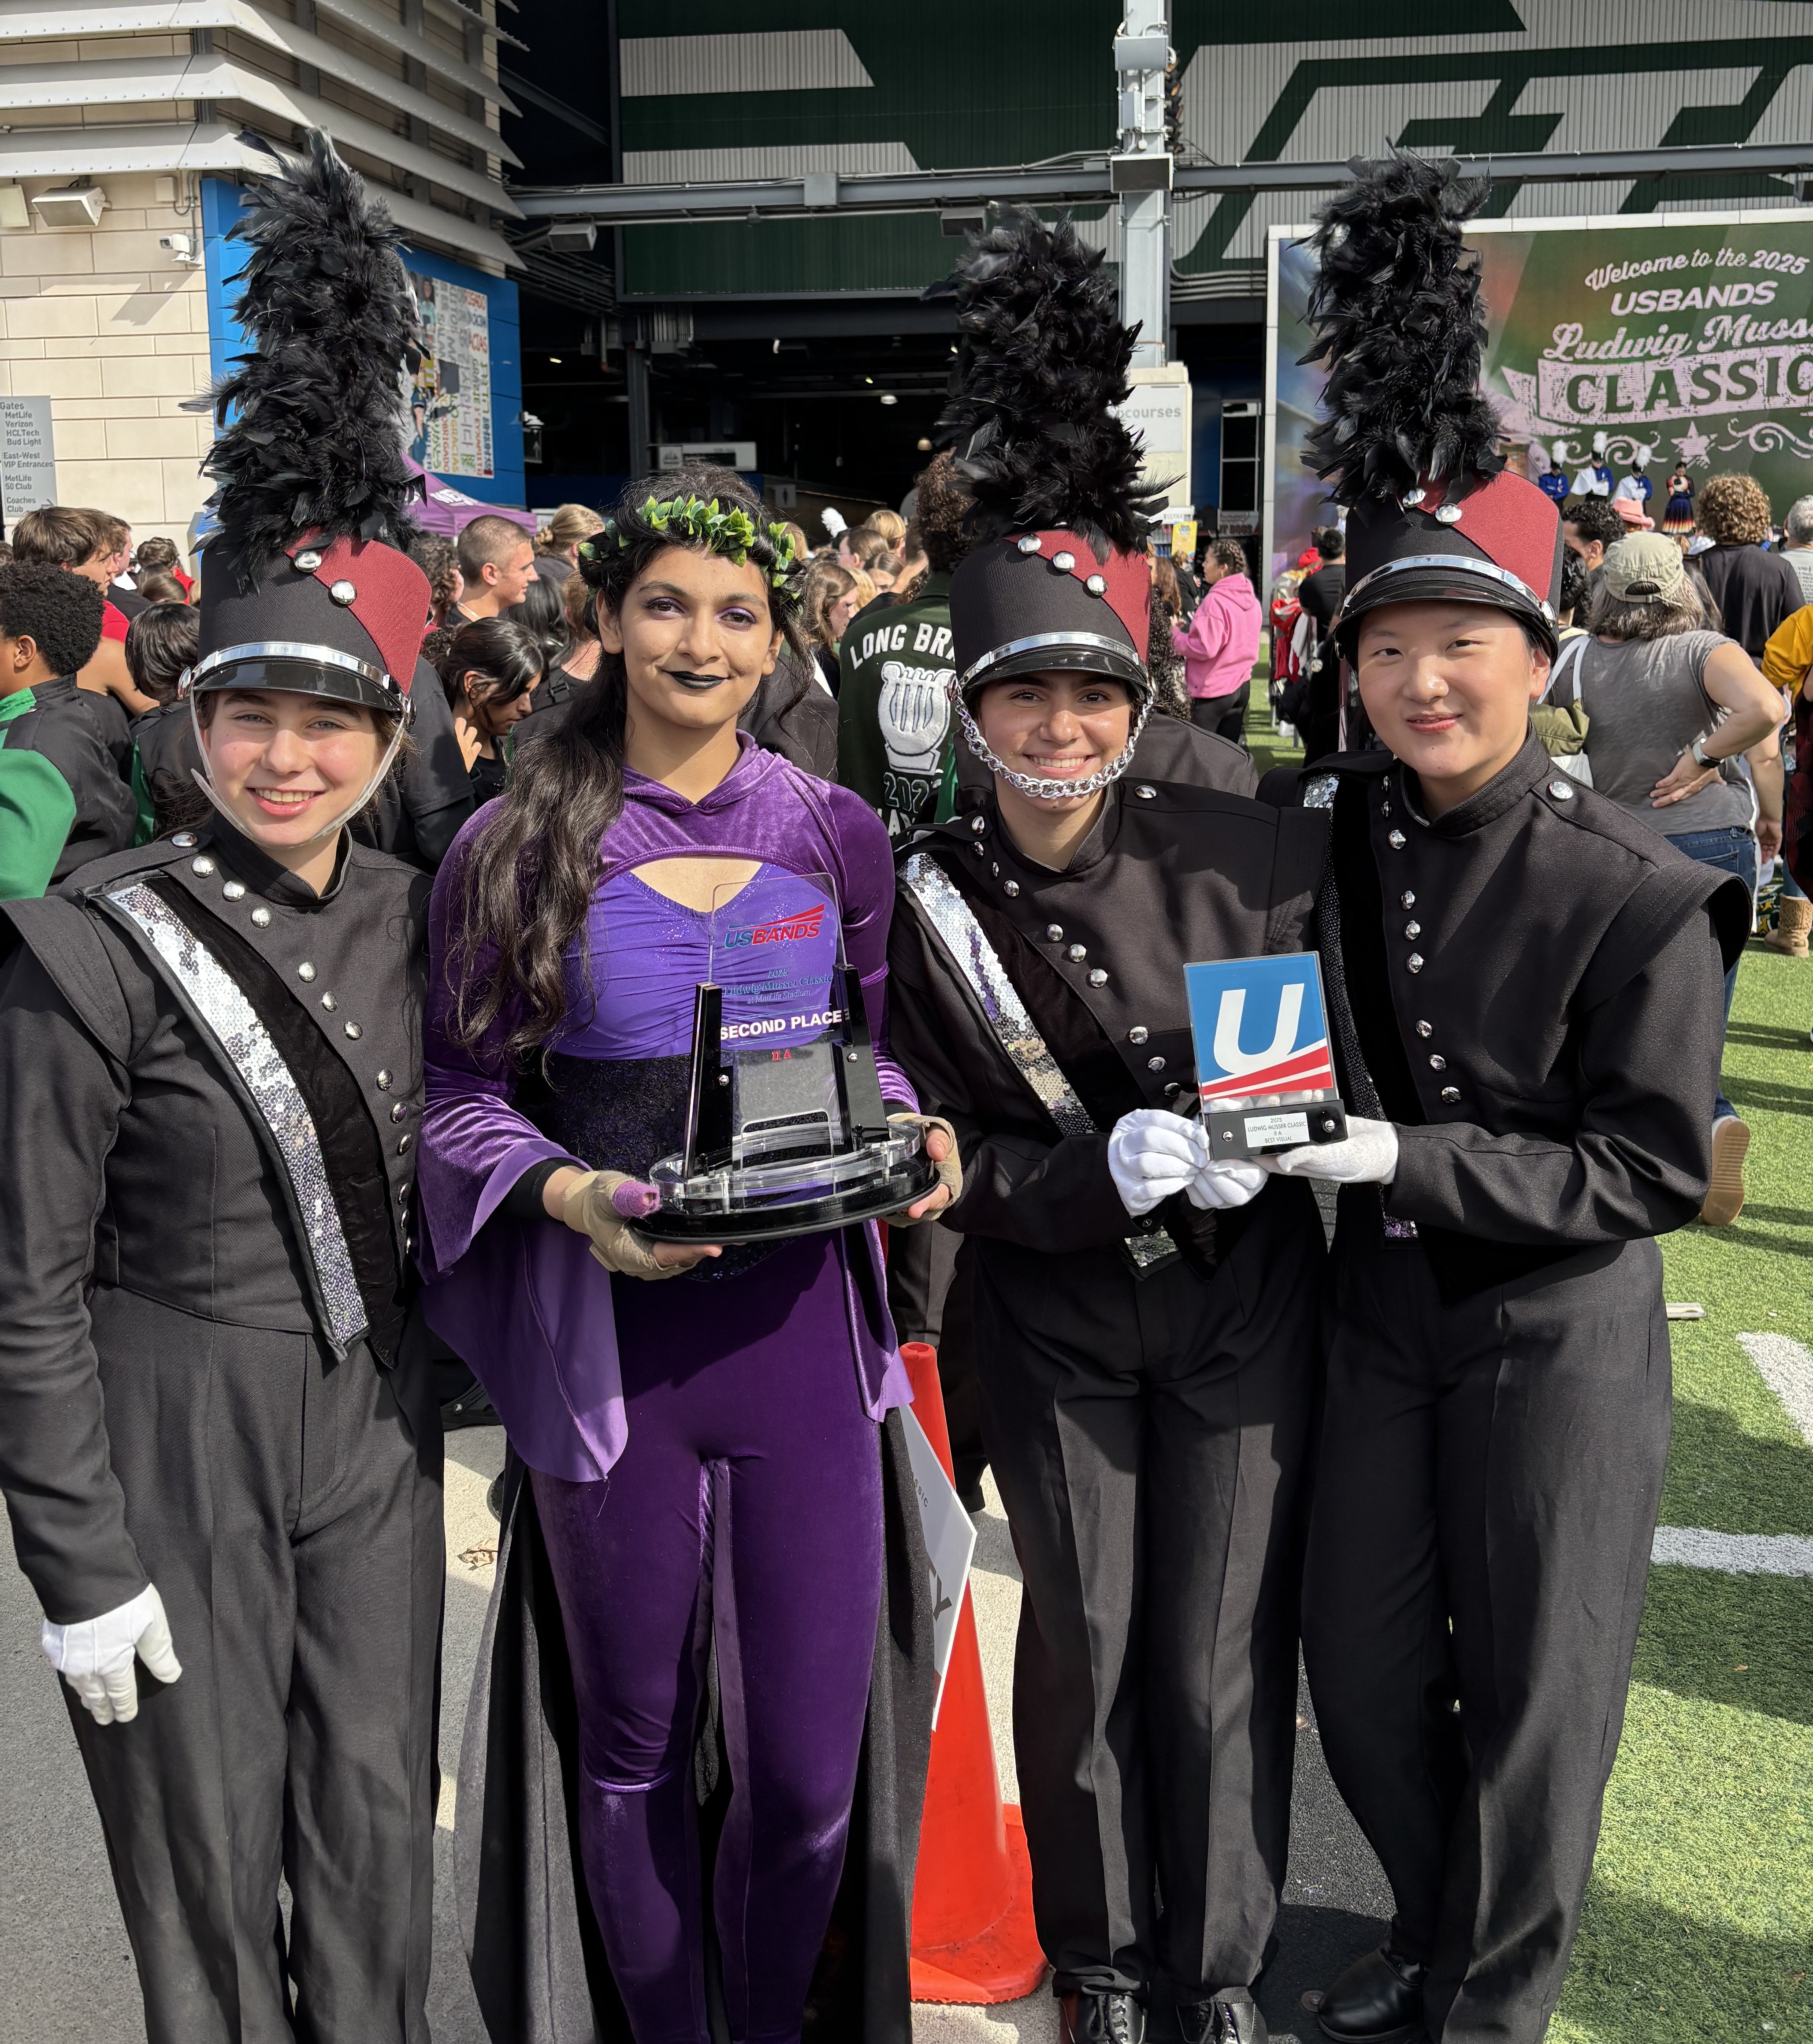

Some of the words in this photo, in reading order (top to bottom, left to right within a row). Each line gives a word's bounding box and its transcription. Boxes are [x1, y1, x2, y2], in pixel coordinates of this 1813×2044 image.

[1585, 253, 1689, 291] Welcome
[1690, 248, 1713, 267] to
[1716, 247, 1748, 267] the
[1749, 249, 1810, 275] 2025
[1610, 280, 1779, 316] USBANDS
[1543, 322, 1693, 367] Ludwig
[1697, 314, 1813, 353] Muss
[1566, 354, 1813, 414] CLASSIC
[0, 401, 25, 410] Gates
[5, 411, 33, 419] MetLife
[23, 438, 42, 446] Light
[450, 420, 459, 473] GRACIAS
[850, 623, 907, 670] LONG
[724, 922, 821, 948] USBANDS
[724, 983, 761, 998] Ludwig
[762, 979, 797, 991] Musser
[799, 973, 832, 986] Classic
[768, 969, 788, 978] 2025
[783, 989, 811, 999] Stadium
[720, 1018, 786, 1040] SECOND
[791, 1010, 842, 1030] PLACE
[1213, 983, 1305, 1074] U
[783, 1049, 792, 1059] A
